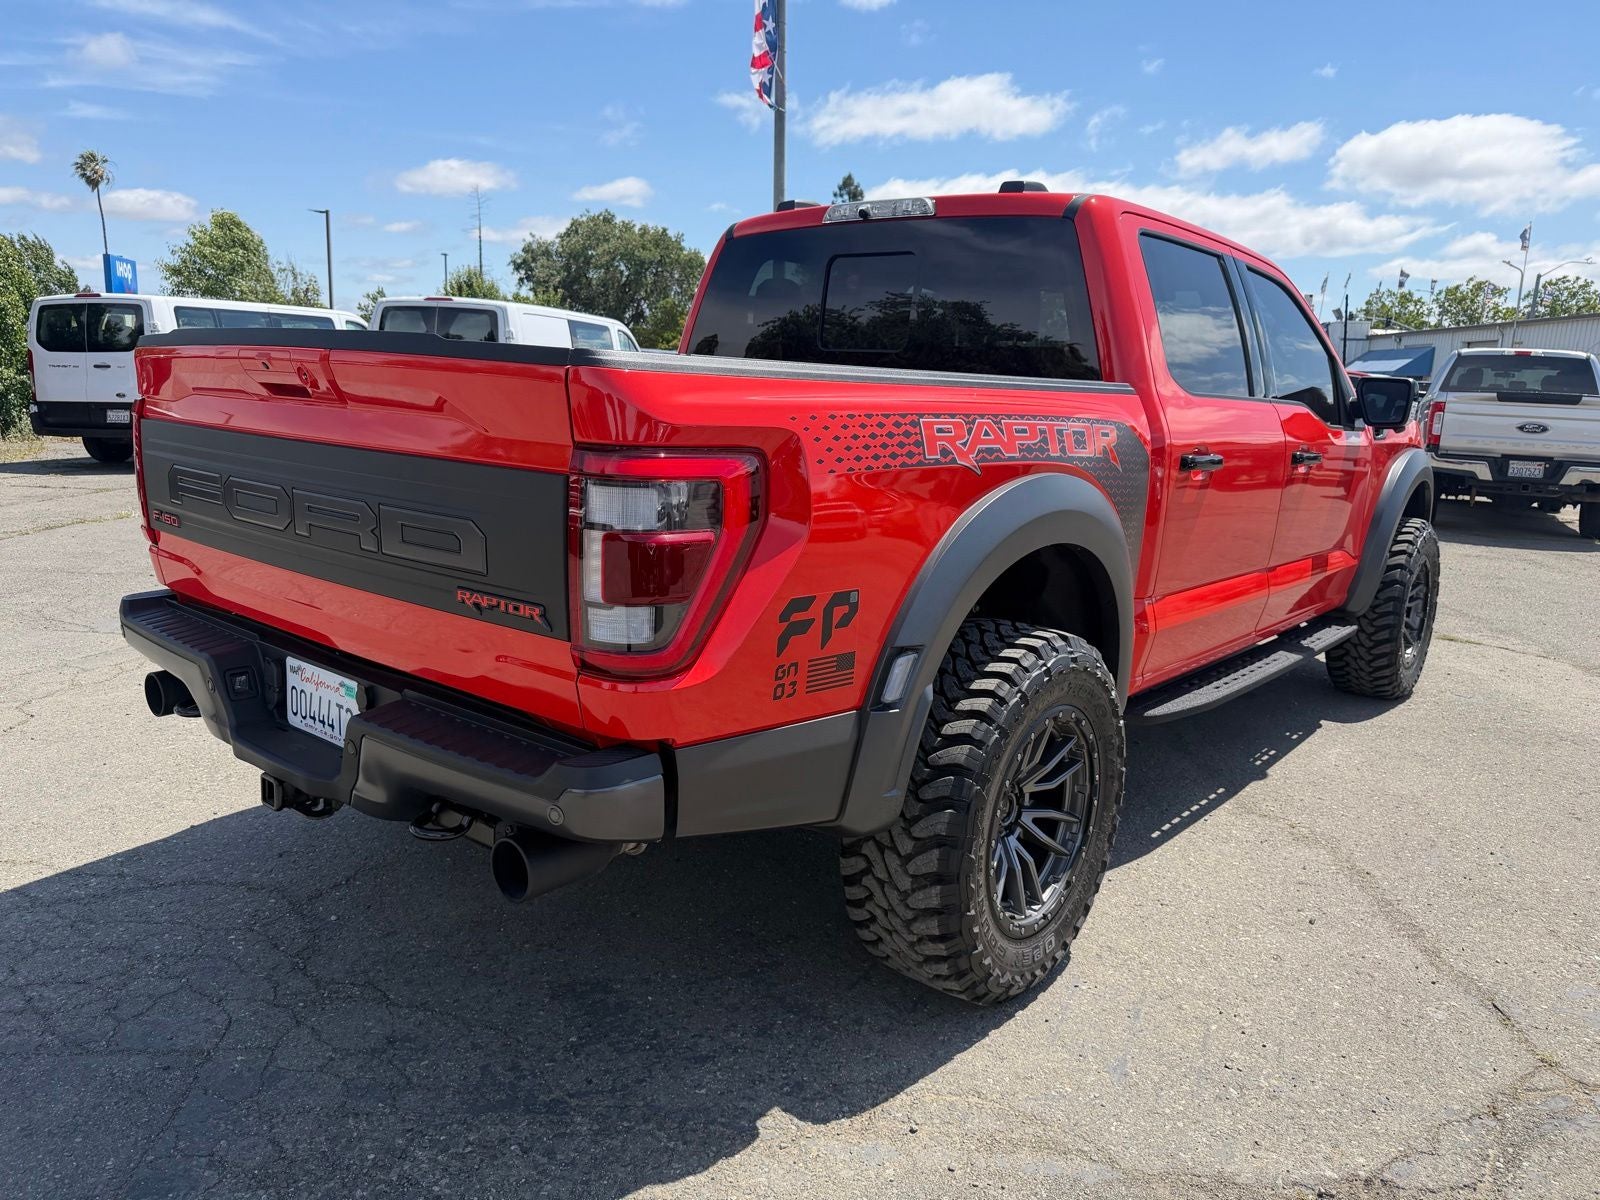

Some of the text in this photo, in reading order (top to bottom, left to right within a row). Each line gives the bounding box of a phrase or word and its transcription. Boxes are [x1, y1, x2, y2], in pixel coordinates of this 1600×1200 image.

[920, 418, 1123, 475] RAPTOR
[168, 464, 488, 576] FORD
[456, 587, 549, 628] RAPTOR
[300, 667, 341, 692] California
